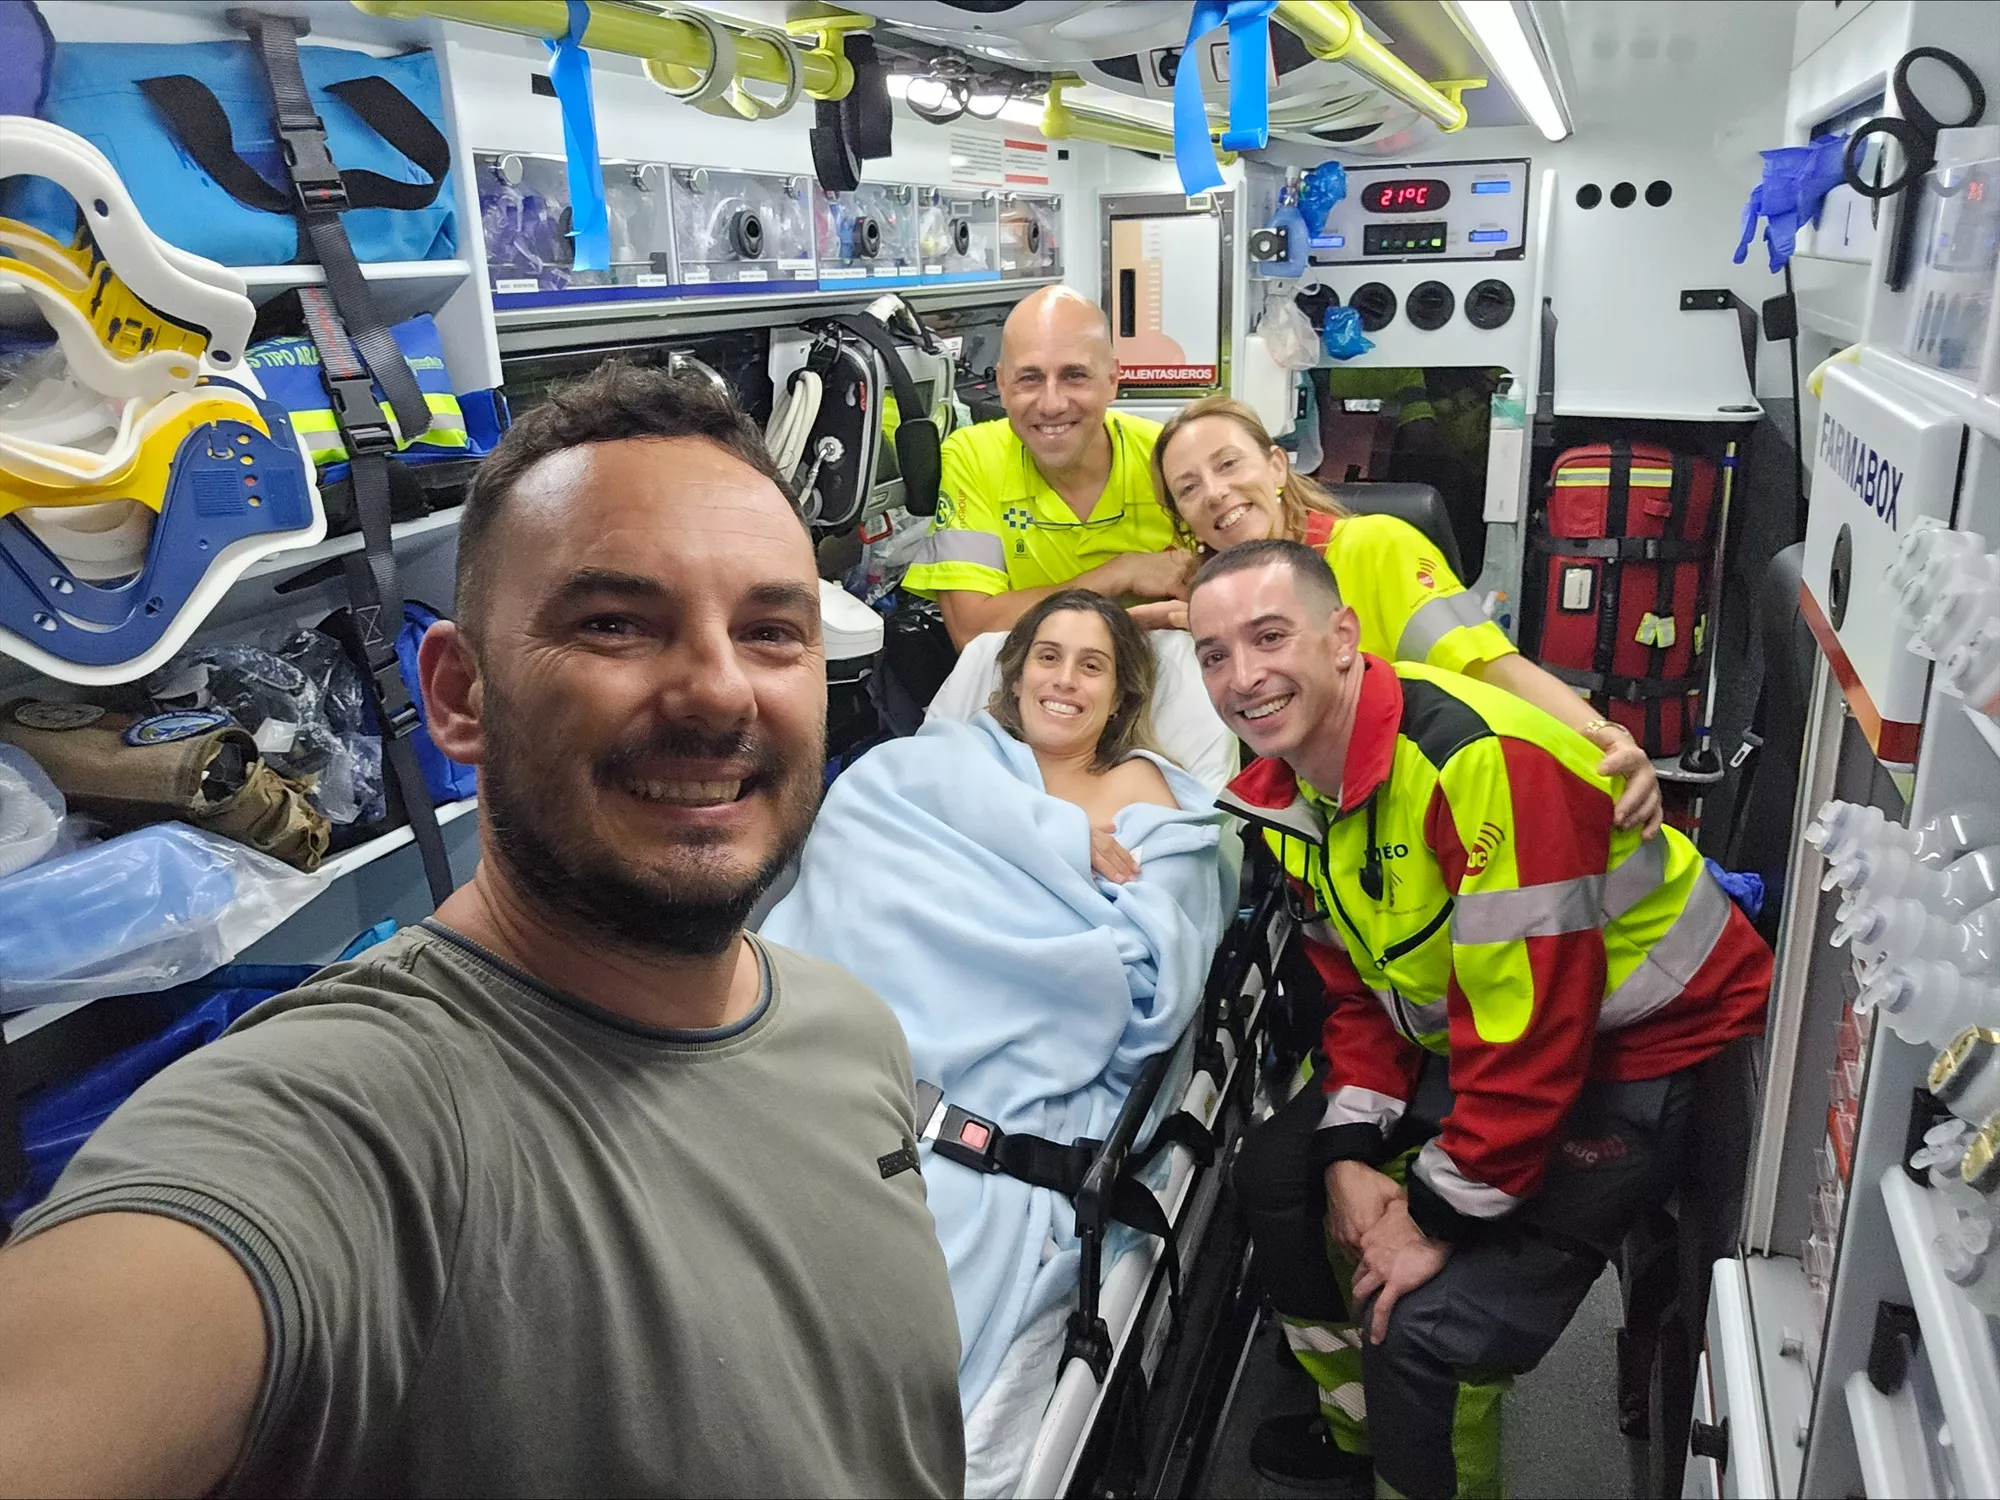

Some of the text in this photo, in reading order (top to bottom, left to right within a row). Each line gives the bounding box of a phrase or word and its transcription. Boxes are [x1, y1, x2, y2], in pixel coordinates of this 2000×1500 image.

[1380, 186, 1429, 207] 21°C
[256, 348, 295, 367] TIPO
[1820, 412, 1904, 532] FARMABOX
